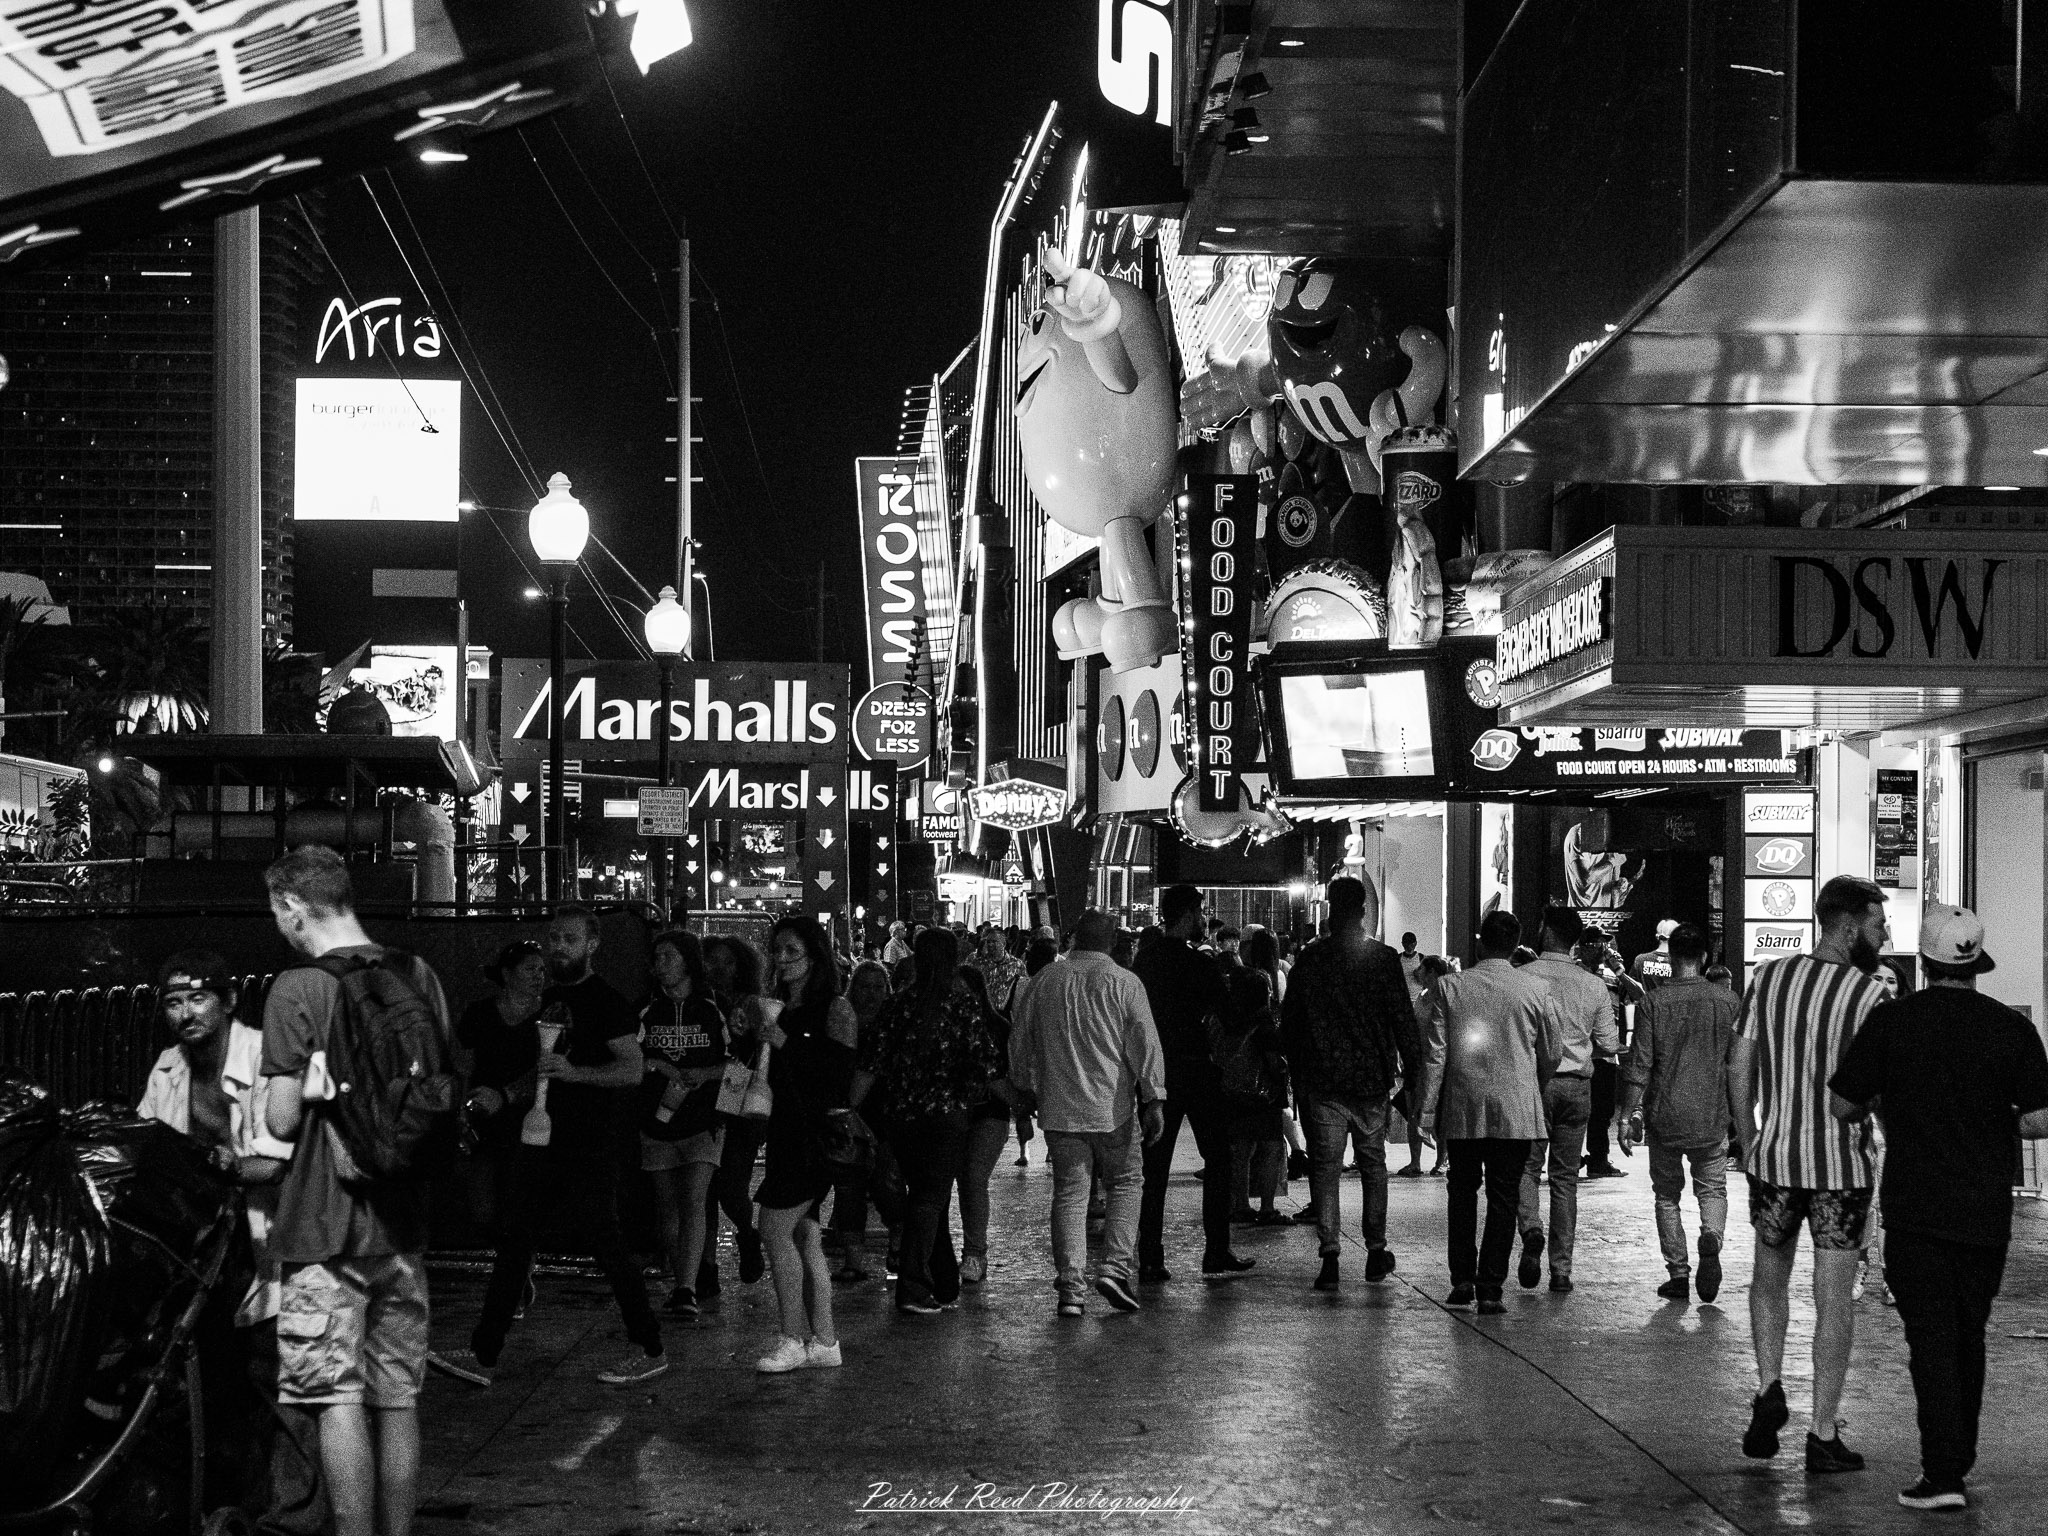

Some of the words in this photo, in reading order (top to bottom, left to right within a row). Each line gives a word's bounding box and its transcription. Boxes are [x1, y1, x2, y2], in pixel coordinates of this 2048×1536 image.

[316, 297, 441, 364] Aria
[1211, 484, 1234, 616] FOOD
[877, 473, 918, 662] ROSS
[1773, 556, 2008, 660] DSW
[1530, 606, 1550, 669] SHOE
[1550, 577, 1602, 660] WAREHOUSE
[512, 677, 837, 744] Marshalls
[870, 701, 927, 717] DRESS
[1209, 631, 1233, 799] COURT
[880, 720, 916, 735] FOR
[1662, 727, 1744, 749] SUBWAY
[875, 738, 920, 753] LESS
[1480, 738, 1514, 761] DQ
[1556, 761, 1583, 775] FOOD
[1584, 760, 1617, 774] COURT
[1618, 760, 1646, 774] OPEN
[1647, 759, 1661, 773] 24
[1662, 759, 1697, 773] HOURS
[1704, 758, 1727, 773] ATM
[1734, 758, 1797, 773] RESTROOMS
[976, 791, 1061, 820] Denny's
[1750, 805, 1811, 821] SUBWAY
[922, 830, 958, 839] footwear
[1764, 846, 1797, 866] DQ
[1756, 933, 1801, 949] sbarro
[1642, 966, 1673, 978] SUPPORT
[646, 1033, 710, 1049] FOOTBALL
